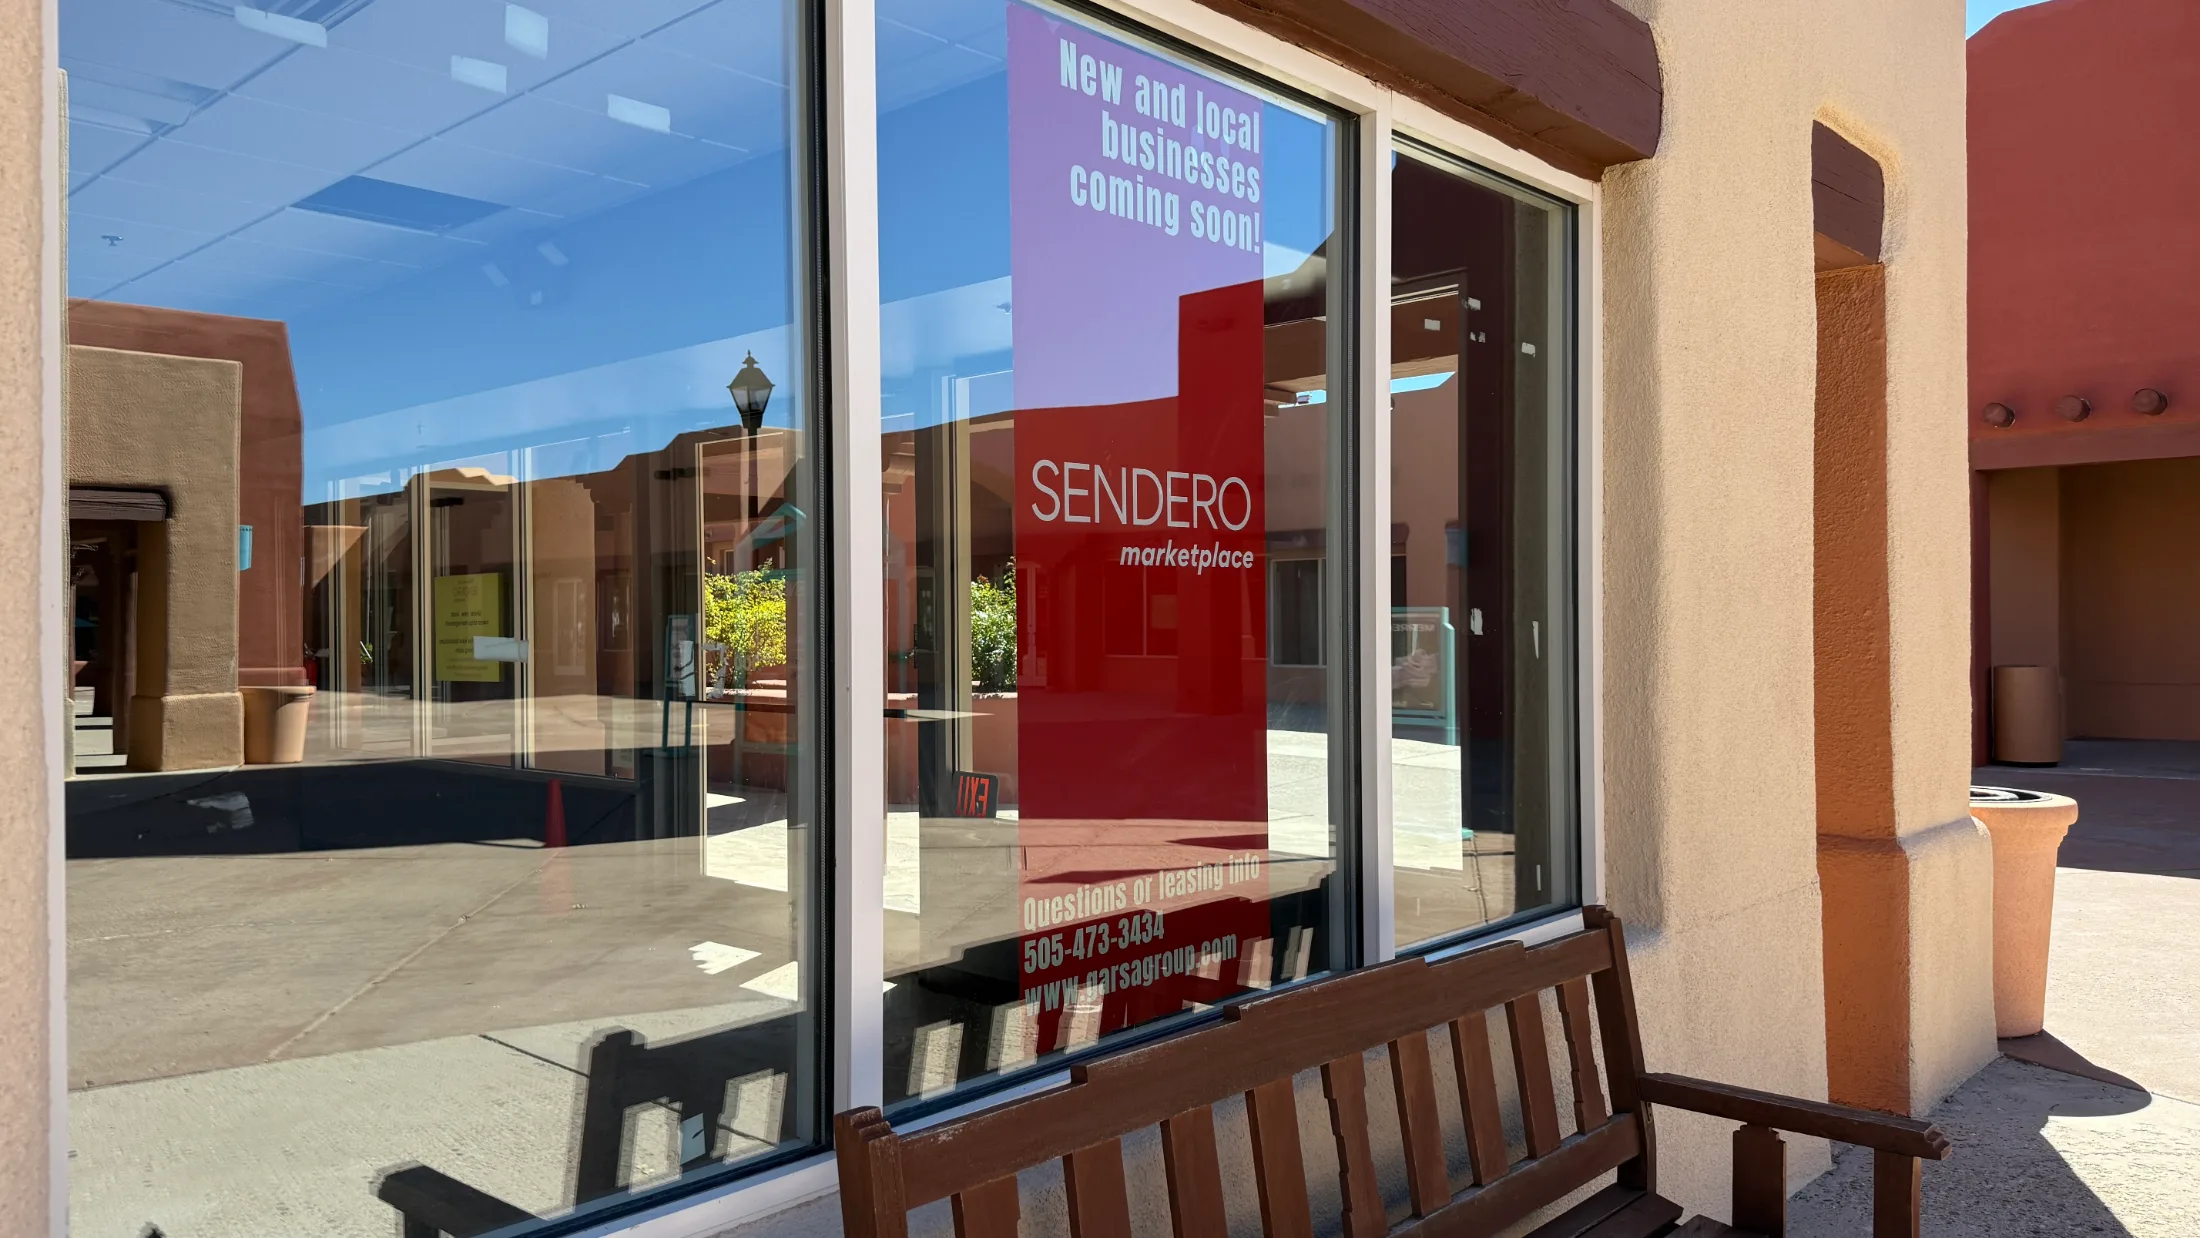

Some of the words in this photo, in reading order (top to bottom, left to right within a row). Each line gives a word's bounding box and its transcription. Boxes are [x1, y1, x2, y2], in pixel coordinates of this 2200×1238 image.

[1060, 38, 1123, 105] New
[1135, 74, 1186, 129] and
[1196, 90, 1260, 154] local
[1102, 110, 1260, 204] businesses
[1070, 164, 1180, 236] coming
[1190, 200, 1260, 254] soon!
[1031, 459, 1251, 531] SENDERO
[1120, 539, 1254, 575] marketplace
[955, 776, 990, 819] EXIT
[1023, 884, 1127, 931] Questions
[1133, 875, 1153, 905] or
[1159, 861, 1224, 900] leasing
[1229, 853, 1260, 885] info
[1023, 909, 1165, 974] 505-473-3434
[1024, 933, 1238, 1017] www.garsagroup.com
